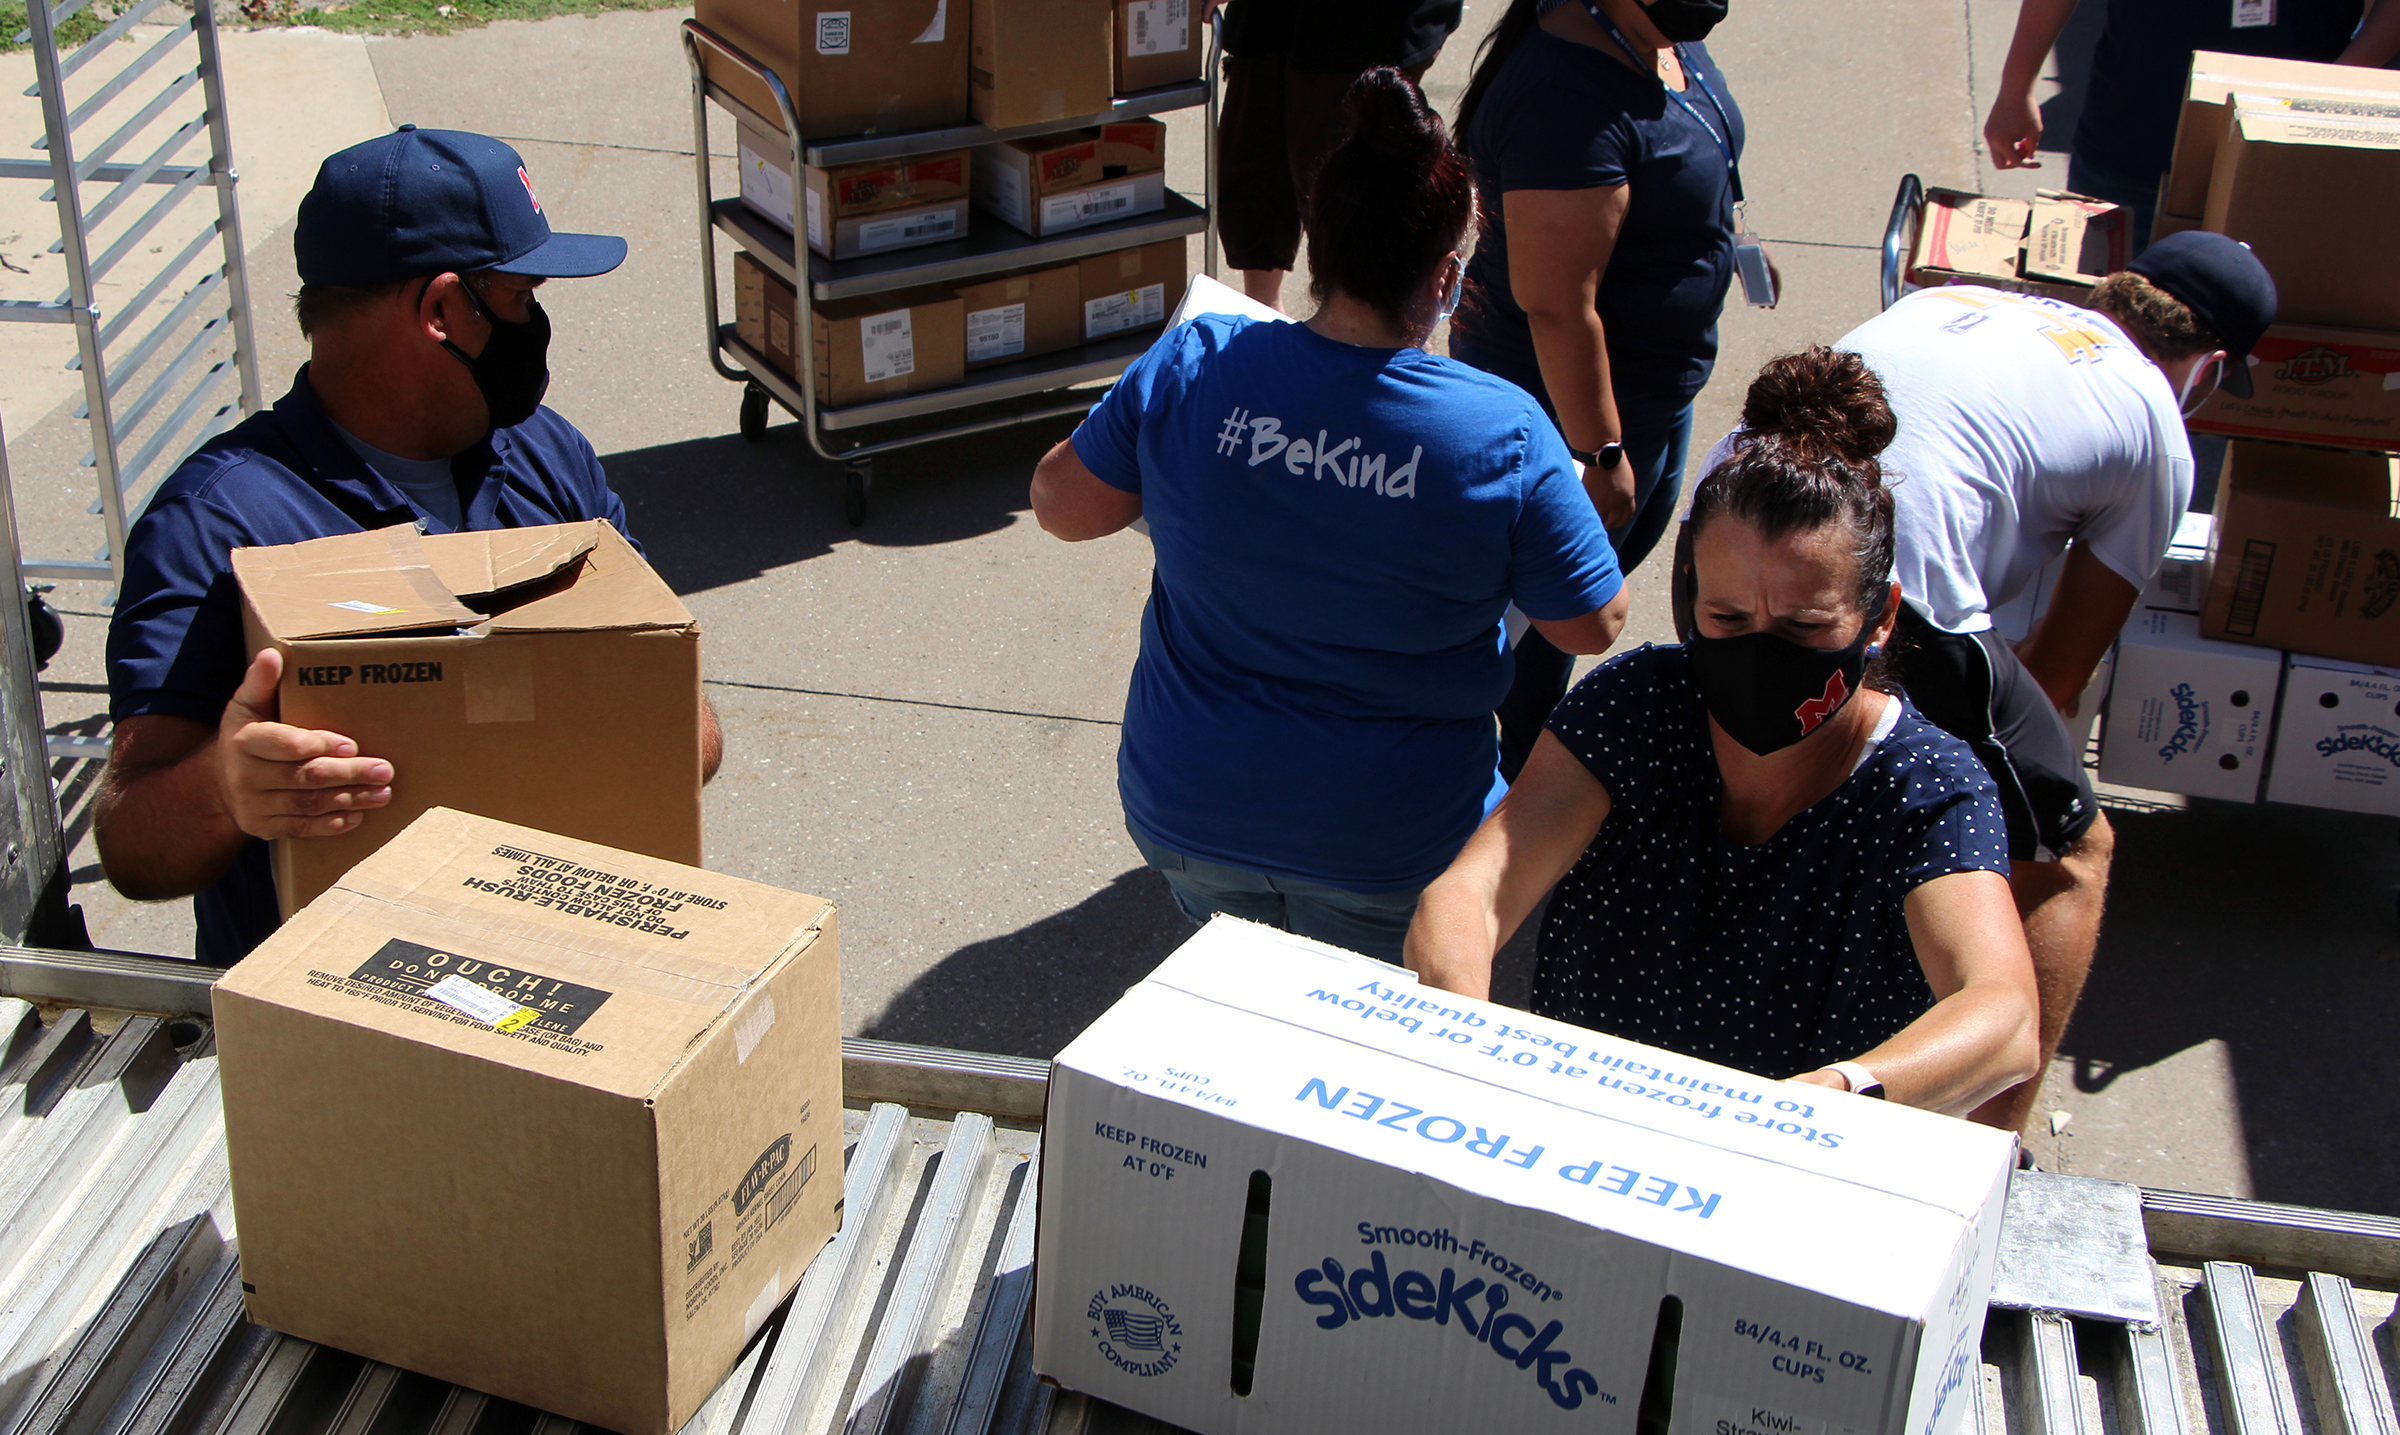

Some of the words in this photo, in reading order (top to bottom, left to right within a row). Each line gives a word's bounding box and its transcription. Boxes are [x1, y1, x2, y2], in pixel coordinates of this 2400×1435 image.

[2272, 384, 2305, 396] FOOD
[2308, 387, 2349, 400] GROUP
[1216, 406, 1423, 499] #BeKind
[298, 664, 352, 686] KEEP
[360, 662, 443, 685] FROZEN
[1794, 667, 1850, 737] M
[490, 846, 535, 862] TIMES
[528, 855, 559, 868] ALL
[514, 864, 593, 889] FOODS
[554, 862, 576, 872] AT
[571, 866, 620, 883] BELOW
[500, 878, 571, 900] CONTENTS
[515, 875, 556, 889] THAW
[554, 885, 576, 894] TO
[616, 877, 640, 888] OR
[666, 889, 689, 900] AT
[460, 876, 691, 940] PERISHABLE-RUSH
[569, 896, 616, 911] ALLOW
[574, 890, 612, 903] CASE
[591, 883, 684, 912] FROZEN
[610, 899, 644, 911] THIS
[683, 893, 729, 910] STORE
[614, 907, 646, 919] NOT
[642, 907, 663, 916] OF
[644, 915, 666, 924] DO
[358, 973, 414, 992] PRODUCT
[421, 951, 565, 996] OUCH!
[389, 960, 419, 973] DO
[539, 998, 575, 1014] ME
[308, 970, 347, 983] REMOVE
[343, 979, 386, 994] DESIRED
[382, 989, 423, 1004] AMOUNT
[419, 999, 436, 1007] OF
[515, 1024, 543, 1036] CASE
[539, 1030, 560, 1041] (OR
[557, 1034, 583, 1047] BAG)
[584, 1042, 605, 1053] AND
[1302, 984, 1427, 1031] below
[1353, 976, 1492, 1028] quality
[305, 977, 333, 988] HEAT
[368, 994, 400, 1006] PRIOR
[397, 1001, 413, 1009] TO
[410, 1005, 452, 1020] SERVING
[449, 1015, 471, 1025] FOR
[468, 1020, 495, 1031] FOOD
[492, 1026, 531, 1041] SAFETY
[528, 1036, 550, 1046] AND
[548, 1041, 591, 1057] QUALITY.
[501, 1018, 519, 1030] 2
[1428, 1020, 1478, 1045] or
[1493, 1017, 1584, 1054] best
[1164, 1067, 1211, 1085] CUPS
[1544, 1053, 1594, 1078] at
[1584, 1044, 1767, 1106] maintain
[1180, 1085, 1238, 1107] 84/4.4
[1595, 1068, 1732, 1116] frozen
[1765, 1097, 1820, 1120] to
[1292, 1074, 1549, 1169] FROZEN
[1729, 1106, 1849, 1149] Store
[1095, 1122, 1136, 1146] KEEP
[1140, 1136, 1207, 1169] FROZEN
[1123, 1155, 1147, 1172] AT
[1149, 1162, 1175, 1181] 0°F
[1552, 1153, 1732, 1219] KEEP
[1087, 1290, 1108, 1321] BUY
[1111, 1283, 1183, 1336] AMERICAN
[1098, 1341, 1178, 1377] COMPLIANT
[1734, 1318, 1800, 1353] 84/4.4
[1805, 1340, 1832, 1363] FL.
[1838, 1350, 1872, 1375] OZ.
[1772, 1355, 1826, 1384] CUPS
[1751, 1407, 1802, 1434] Kiwi-
